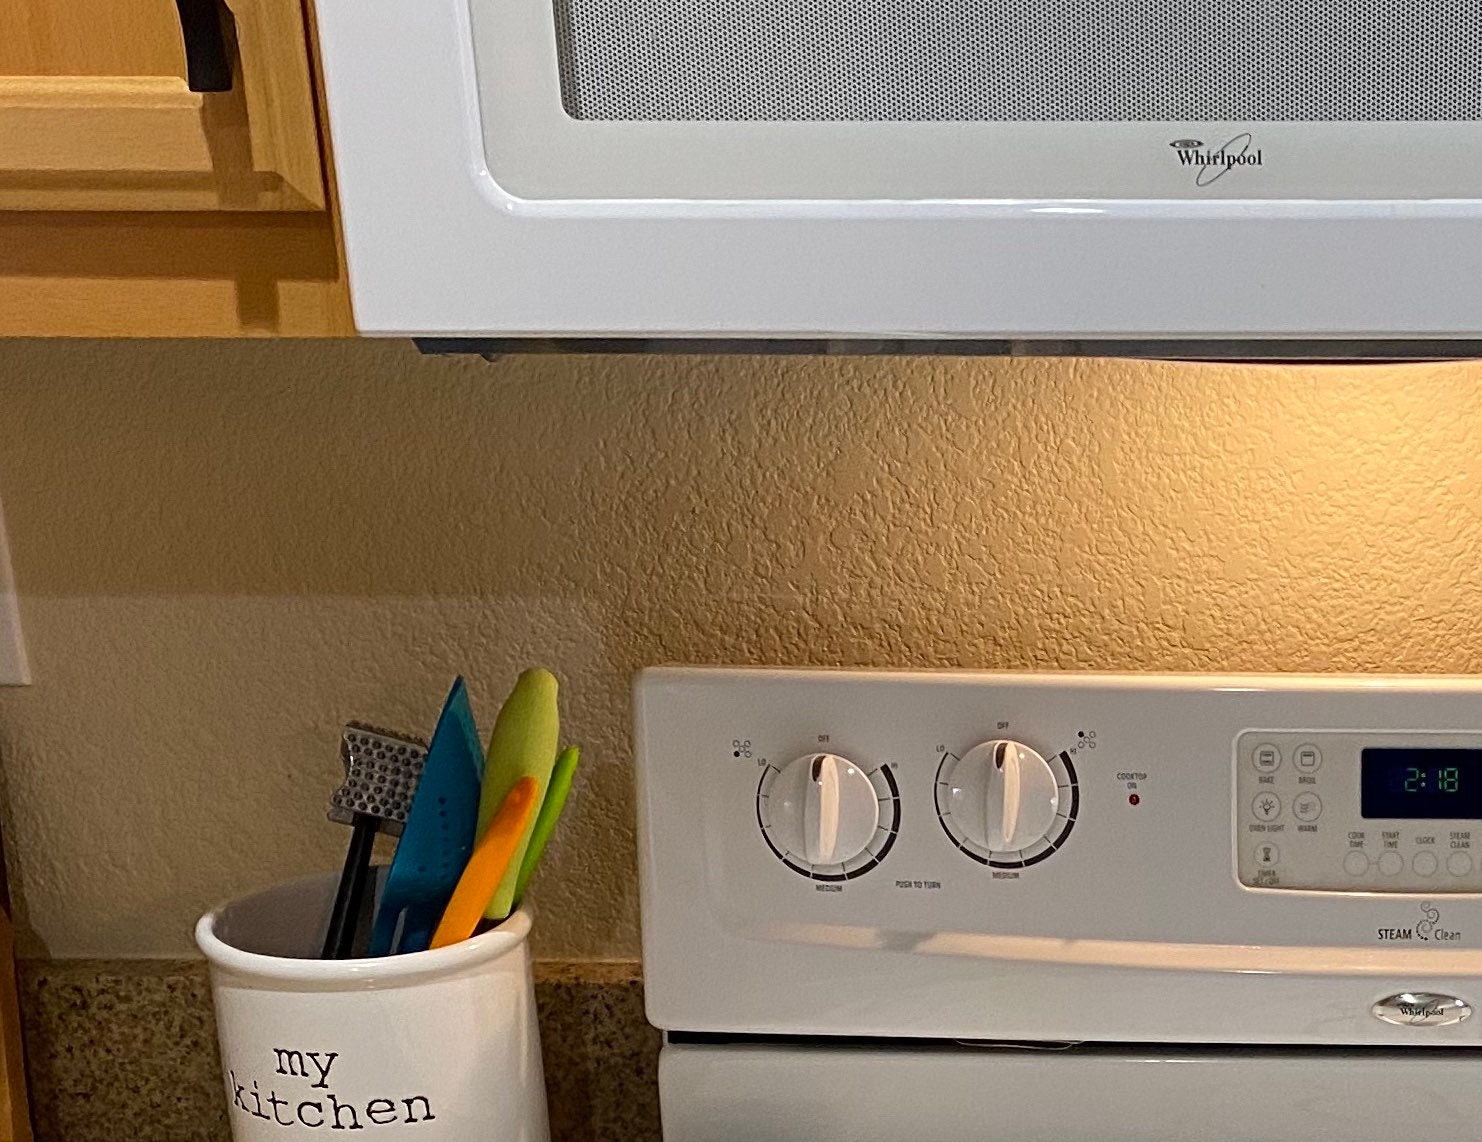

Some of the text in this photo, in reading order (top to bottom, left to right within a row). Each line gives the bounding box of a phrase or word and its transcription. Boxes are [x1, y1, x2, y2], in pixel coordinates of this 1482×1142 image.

[1177, 149, 1262, 169] Whirlpool
[1404, 767, 1459, 792] 2:18
[1377, 928, 1461, 941] STEAM Clean
[273, 1047, 339, 1088] my
[229, 1069, 436, 1130] kitchen
